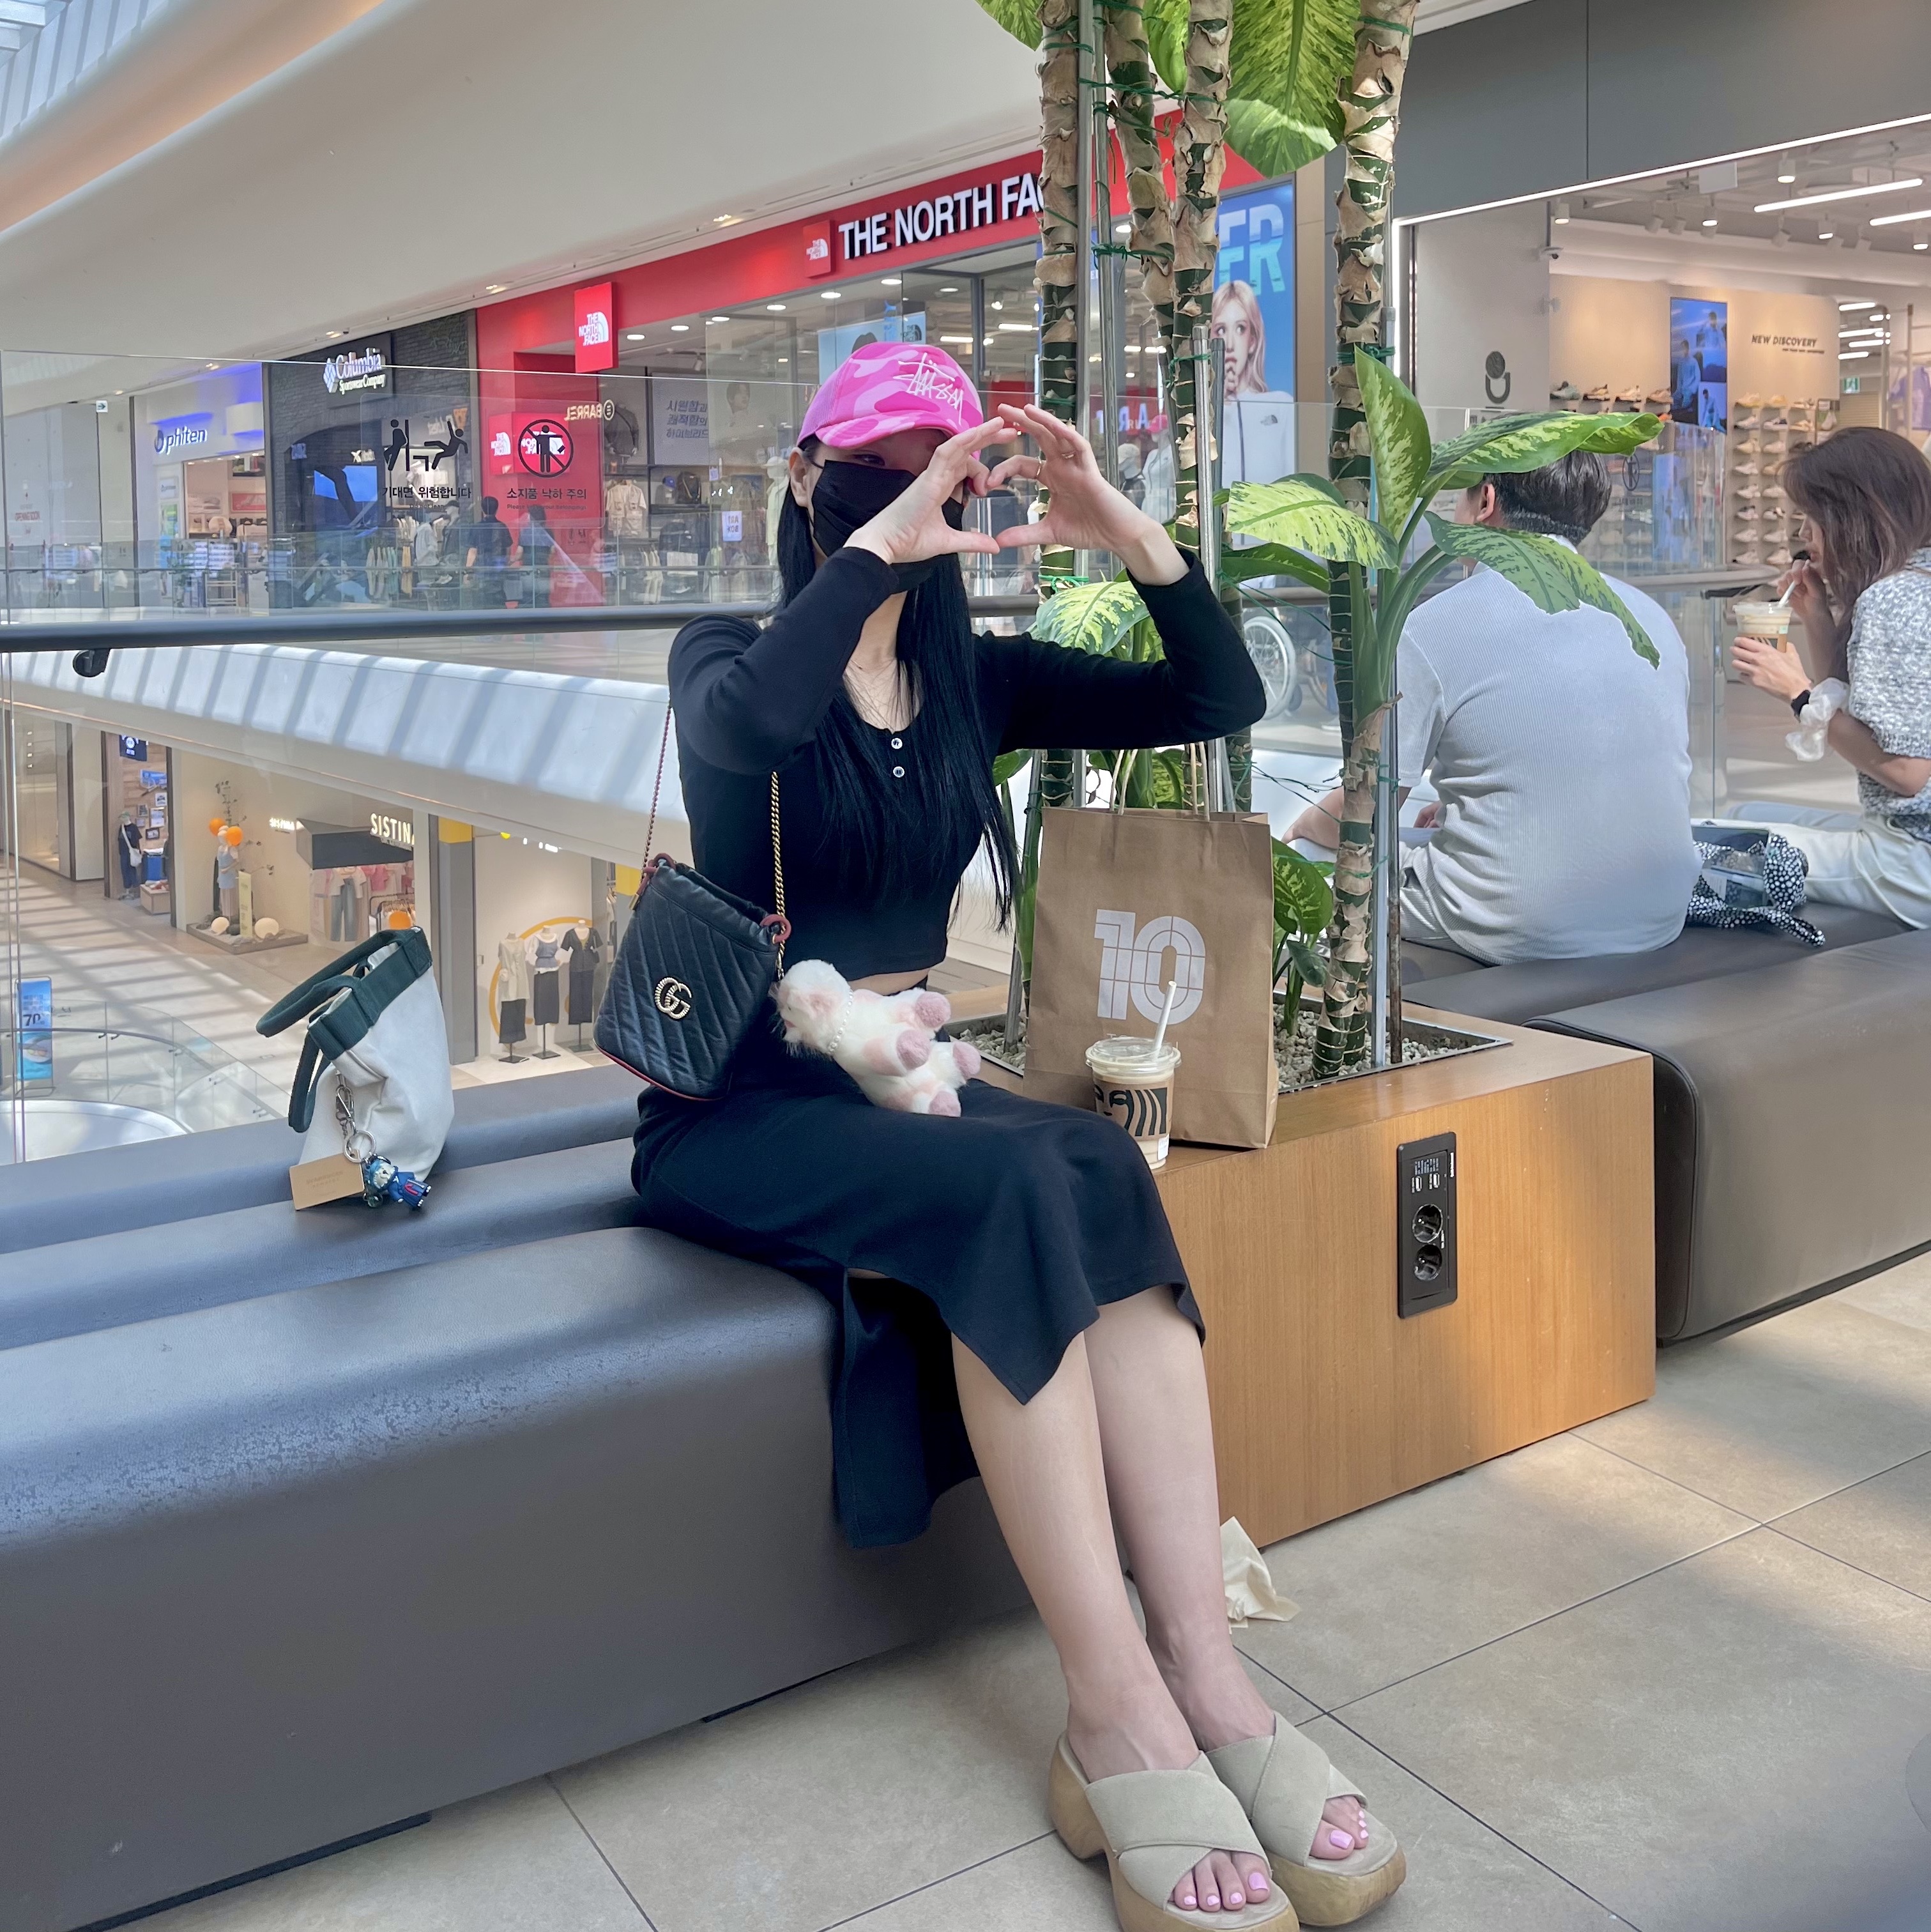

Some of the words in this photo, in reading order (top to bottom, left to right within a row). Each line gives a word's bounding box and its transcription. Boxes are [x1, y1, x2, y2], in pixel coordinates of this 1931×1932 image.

[838, 212, 887, 259] THE
[895, 183, 993, 247] NORTH
[586, 312, 599, 325] THE
[578, 323, 599, 337] NORTH
[1752, 335, 1771, 344] NEW
[1773, 336, 1818, 348] DISCOVERY
[335, 347, 385, 379] Columbia
[165, 425, 208, 456] phiten
[382, 486, 414, 498] 기대면
[417, 486, 472, 499] 위험합니다
[506, 487, 538, 500] 소지품
[542, 488, 563, 500] 낙하
[566, 488, 586, 500] 주의
[1094, 908, 1206, 1025] 10
